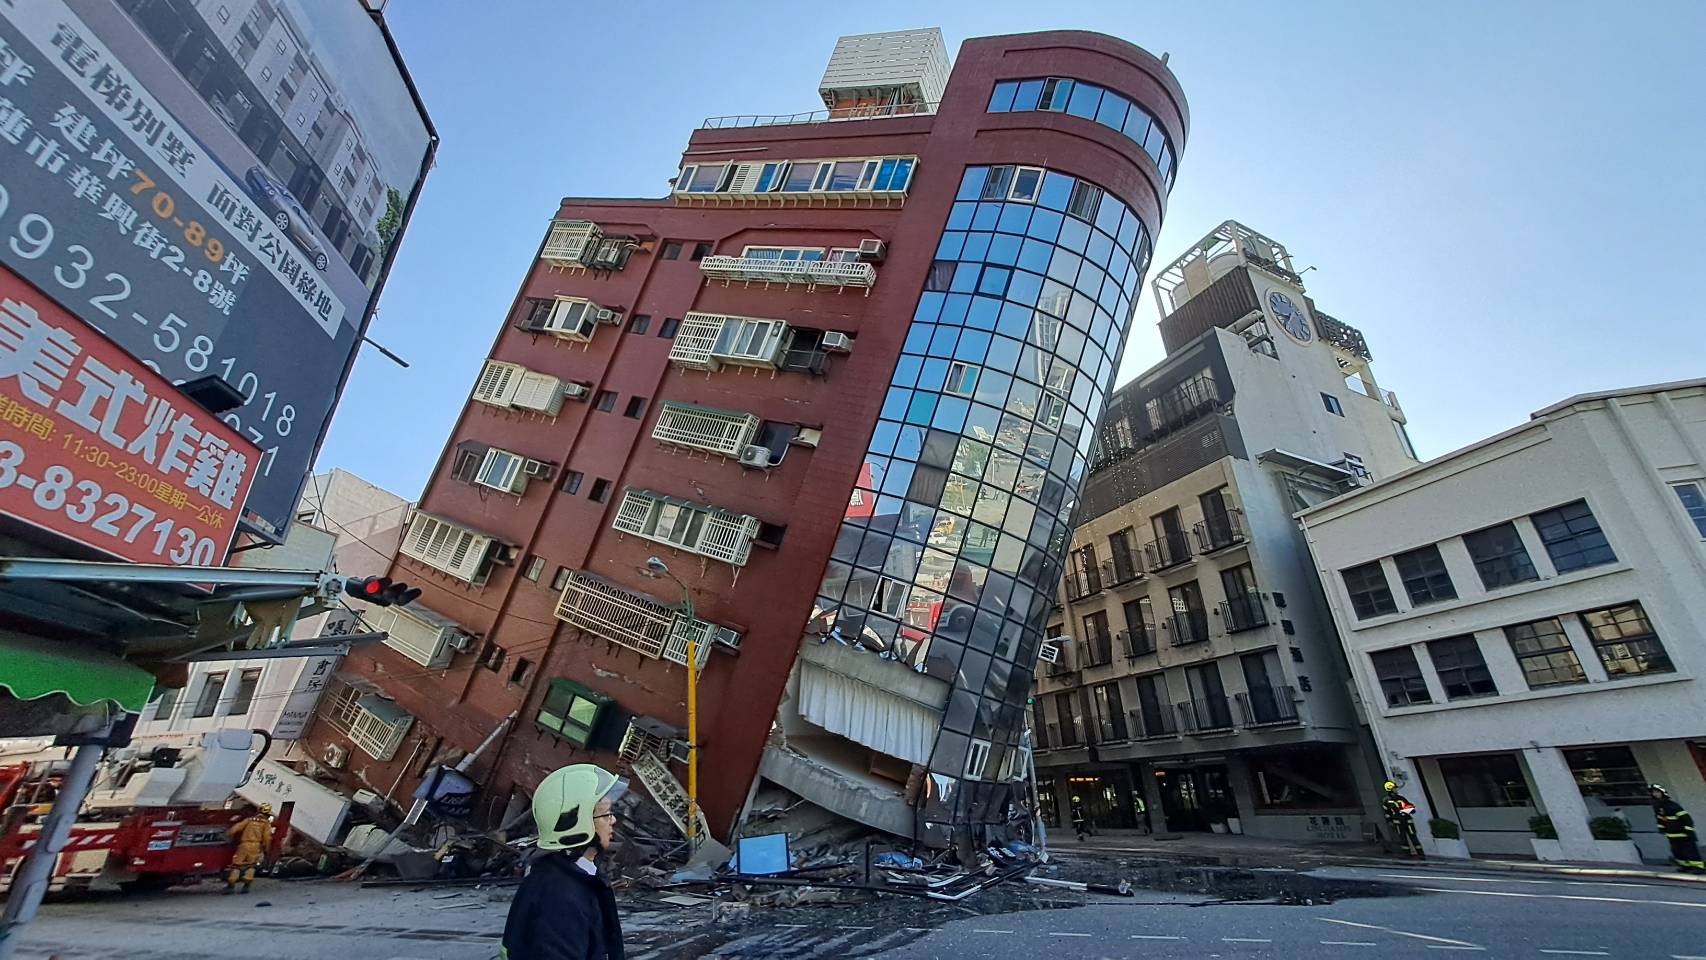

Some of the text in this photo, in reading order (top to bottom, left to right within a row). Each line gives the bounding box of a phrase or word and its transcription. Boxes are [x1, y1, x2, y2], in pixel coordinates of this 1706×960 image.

[0, 95, 236, 315] 蓮市華興街2-8號
[49, 101, 250, 285] 建坪70-89坪
[50, 22, 197, 178] 電梯別墅
[206, 181, 333, 323] 面對公園綠地
[0, 184, 296, 437] 932-581018
[0, 297, 247, 510] 美式炸雞
[0, 440, 216, 567] 3-8327130
